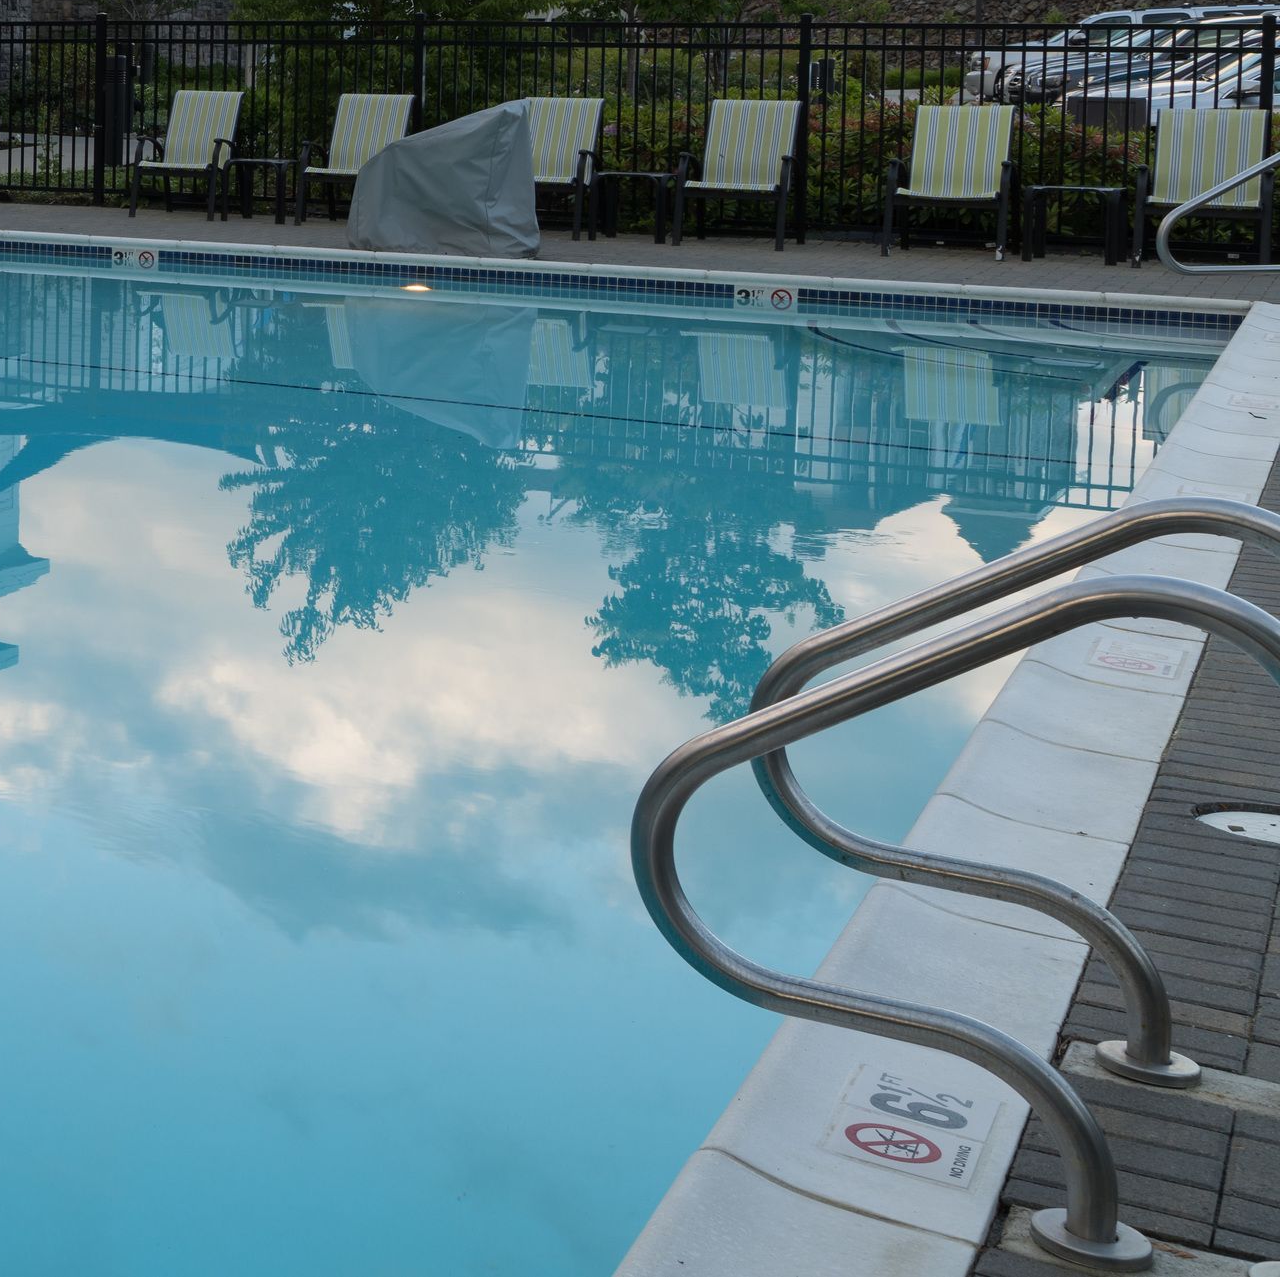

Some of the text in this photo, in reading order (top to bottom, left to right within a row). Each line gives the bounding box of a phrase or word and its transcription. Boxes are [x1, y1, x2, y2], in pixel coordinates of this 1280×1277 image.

[879, 1072, 903, 1086] FT
[869, 1092, 968, 1130] 6
[949, 1144, 972, 1179] NO DIVING
